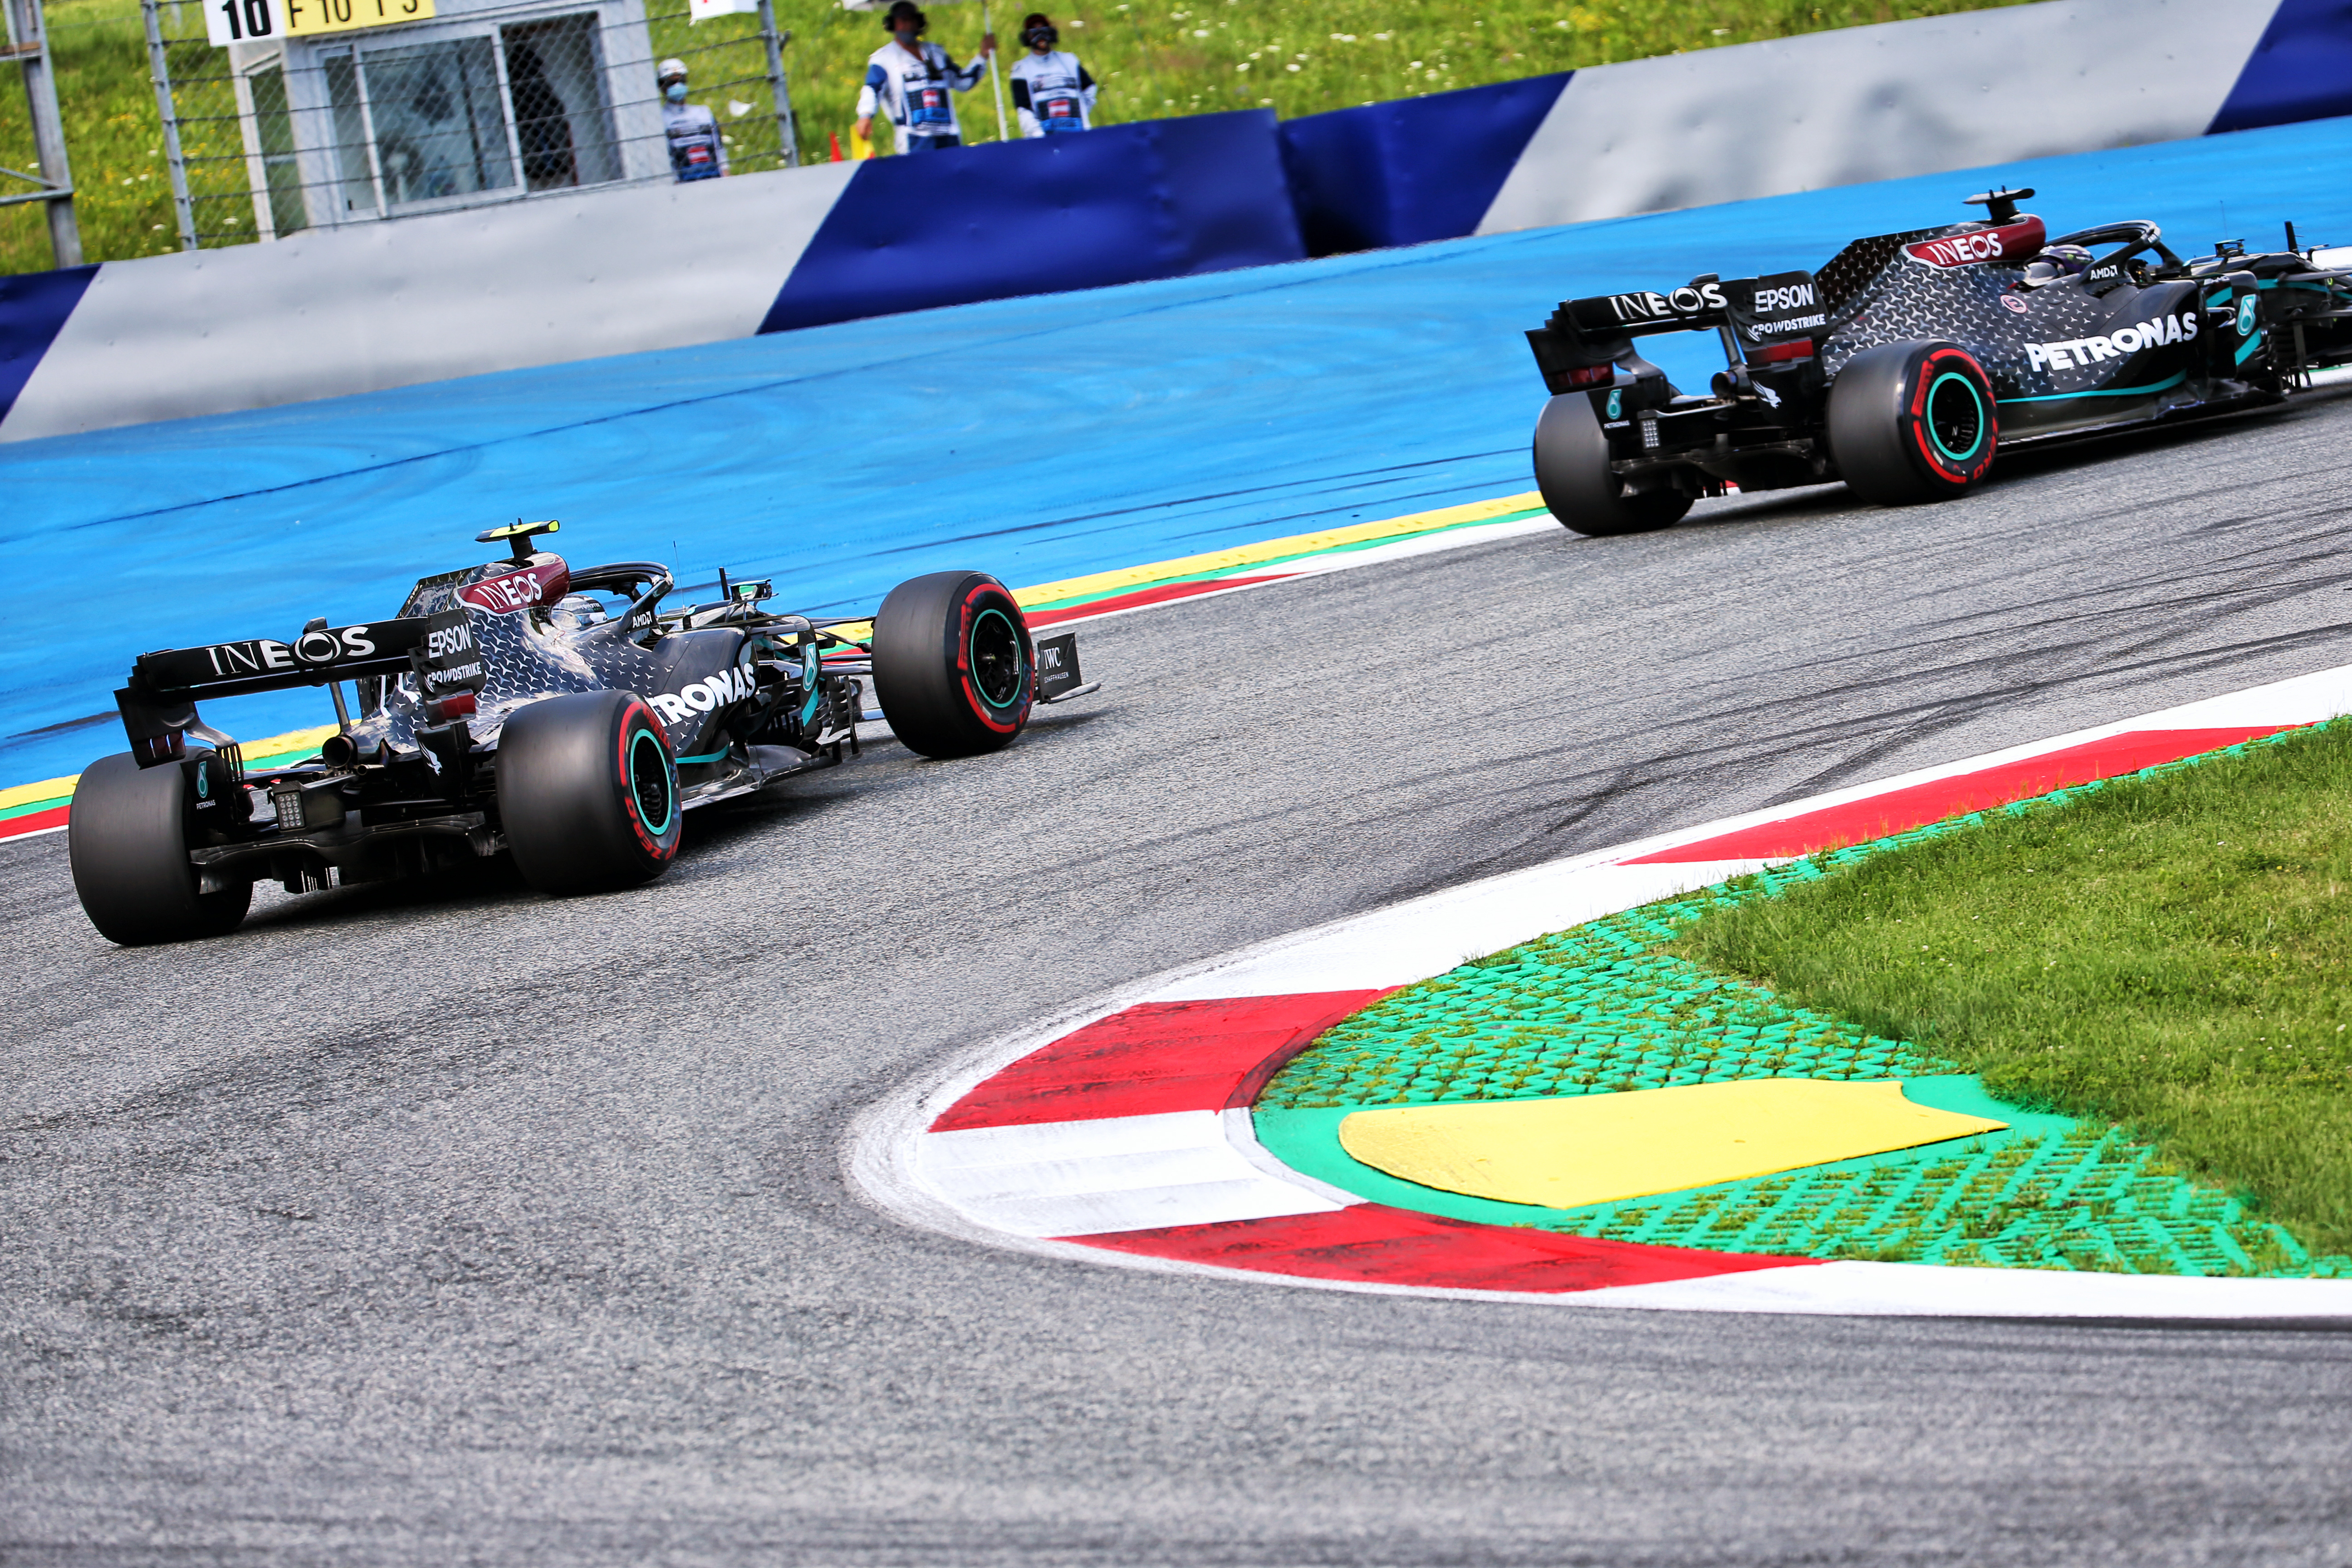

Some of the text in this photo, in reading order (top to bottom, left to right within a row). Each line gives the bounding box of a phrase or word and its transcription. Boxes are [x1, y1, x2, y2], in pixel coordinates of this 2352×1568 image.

[222, 0, 271, 39] 10
[1926, 233, 2003, 265] INEOS
[2090, 267, 2111, 280] AMD
[1608, 283, 1728, 319] INEOS
[1755, 284, 1814, 312] EPSON
[1752, 314, 1826, 335] CROWDSTRIKE
[2024, 312, 2198, 372] PETRONAS
[474, 573, 542, 610] INEOS
[632, 614, 647, 628] AMD
[206, 626, 375, 676] INEOS
[429, 623, 472, 658] EPSON
[1044, 647, 1062, 670] IWC
[427, 662, 482, 686] CROWDSTRIKE
[196, 799, 216, 810] PETRONAS
